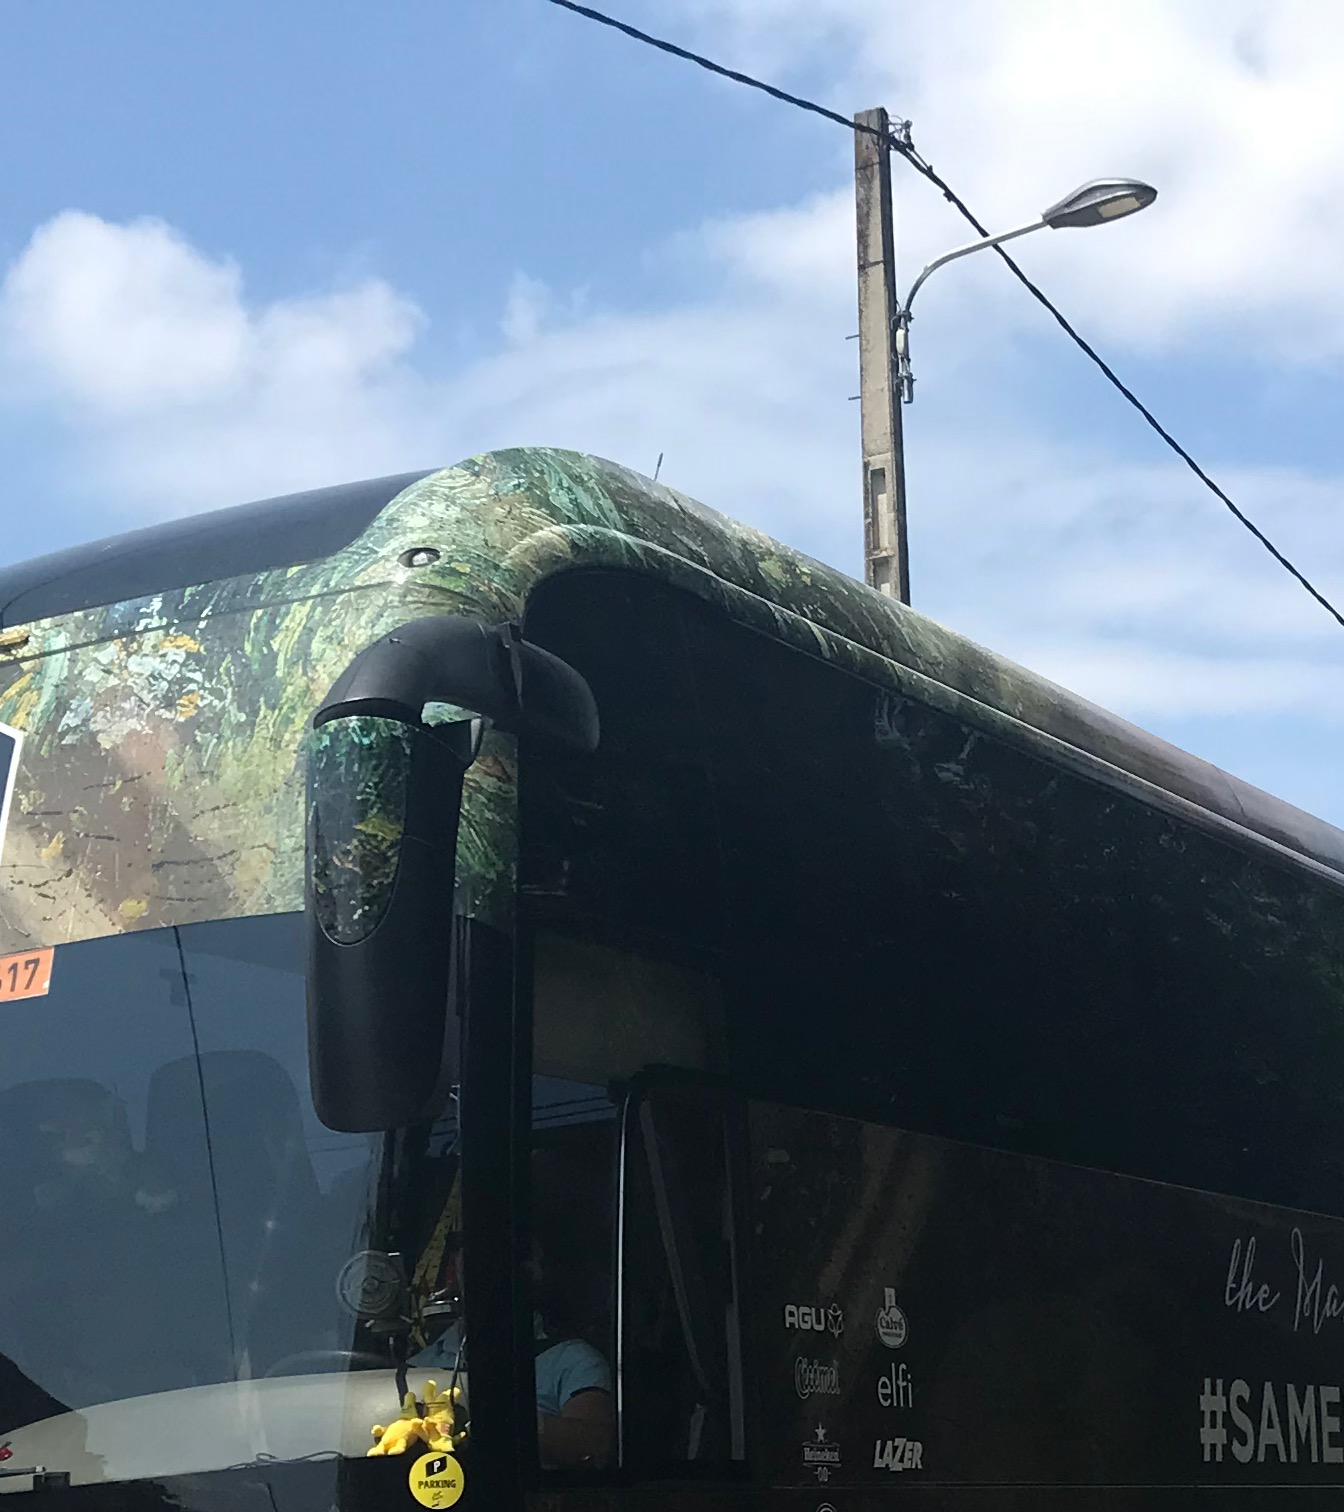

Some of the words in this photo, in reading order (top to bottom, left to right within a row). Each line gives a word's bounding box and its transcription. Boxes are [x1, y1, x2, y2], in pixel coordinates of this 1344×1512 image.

[1225, 1236, 1280, 1312] the
[784, 1304, 825, 1331] AGU
[877, 1362, 913, 1408] elfi
[873, 1437, 923, 1472] LAZER
[418, 1479, 456, 1489] PARKING
